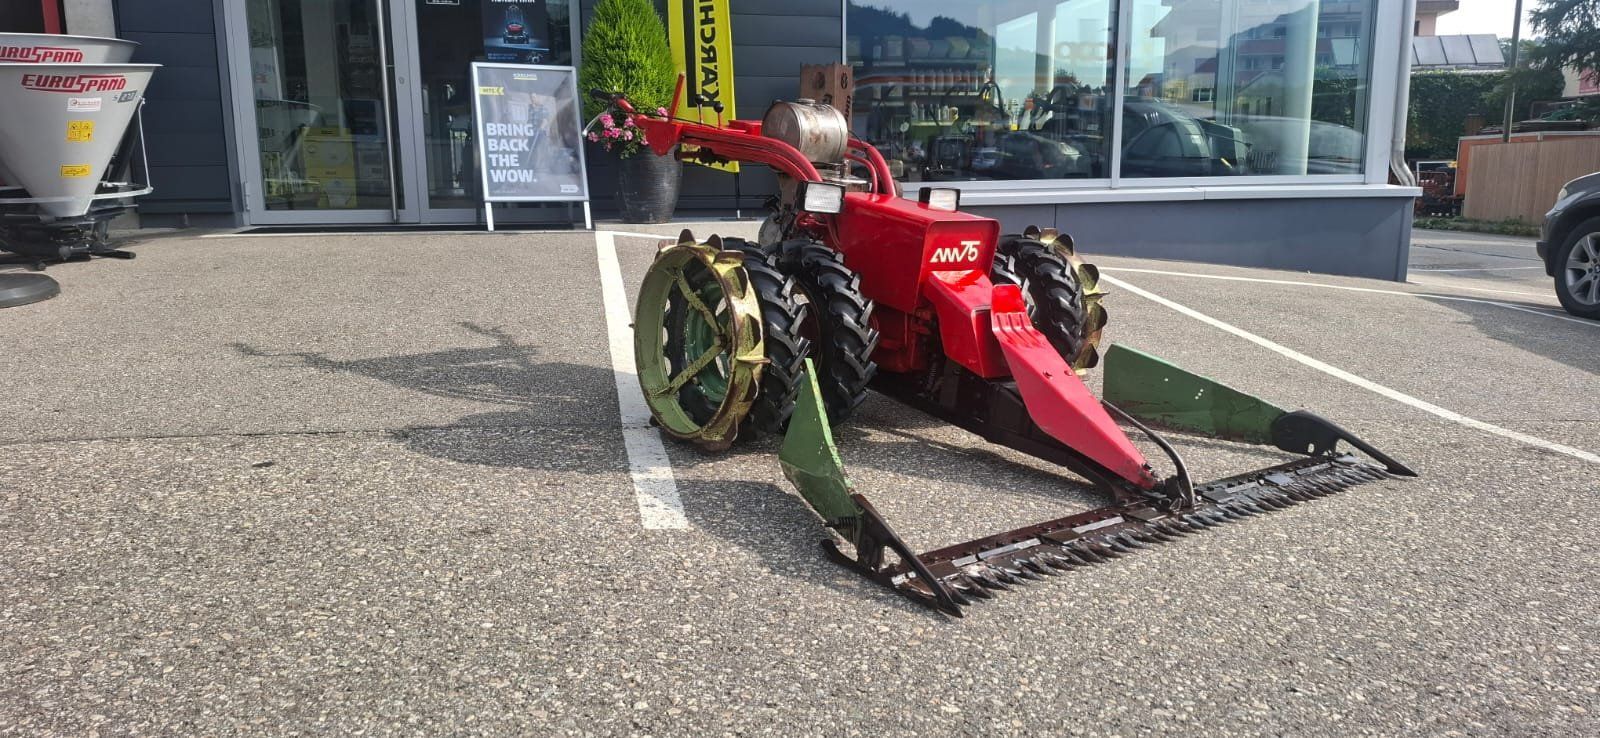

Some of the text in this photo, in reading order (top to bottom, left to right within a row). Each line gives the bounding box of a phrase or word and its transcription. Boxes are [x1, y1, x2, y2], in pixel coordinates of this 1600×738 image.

[0, 46, 84, 63] UROSPAND
[21, 73, 127, 94] EUROSPAND
[486, 123, 534, 136] BRING
[487, 138, 530, 152] BACK
[488, 154, 520, 167] THE
[490, 169, 537, 183] WOW.
